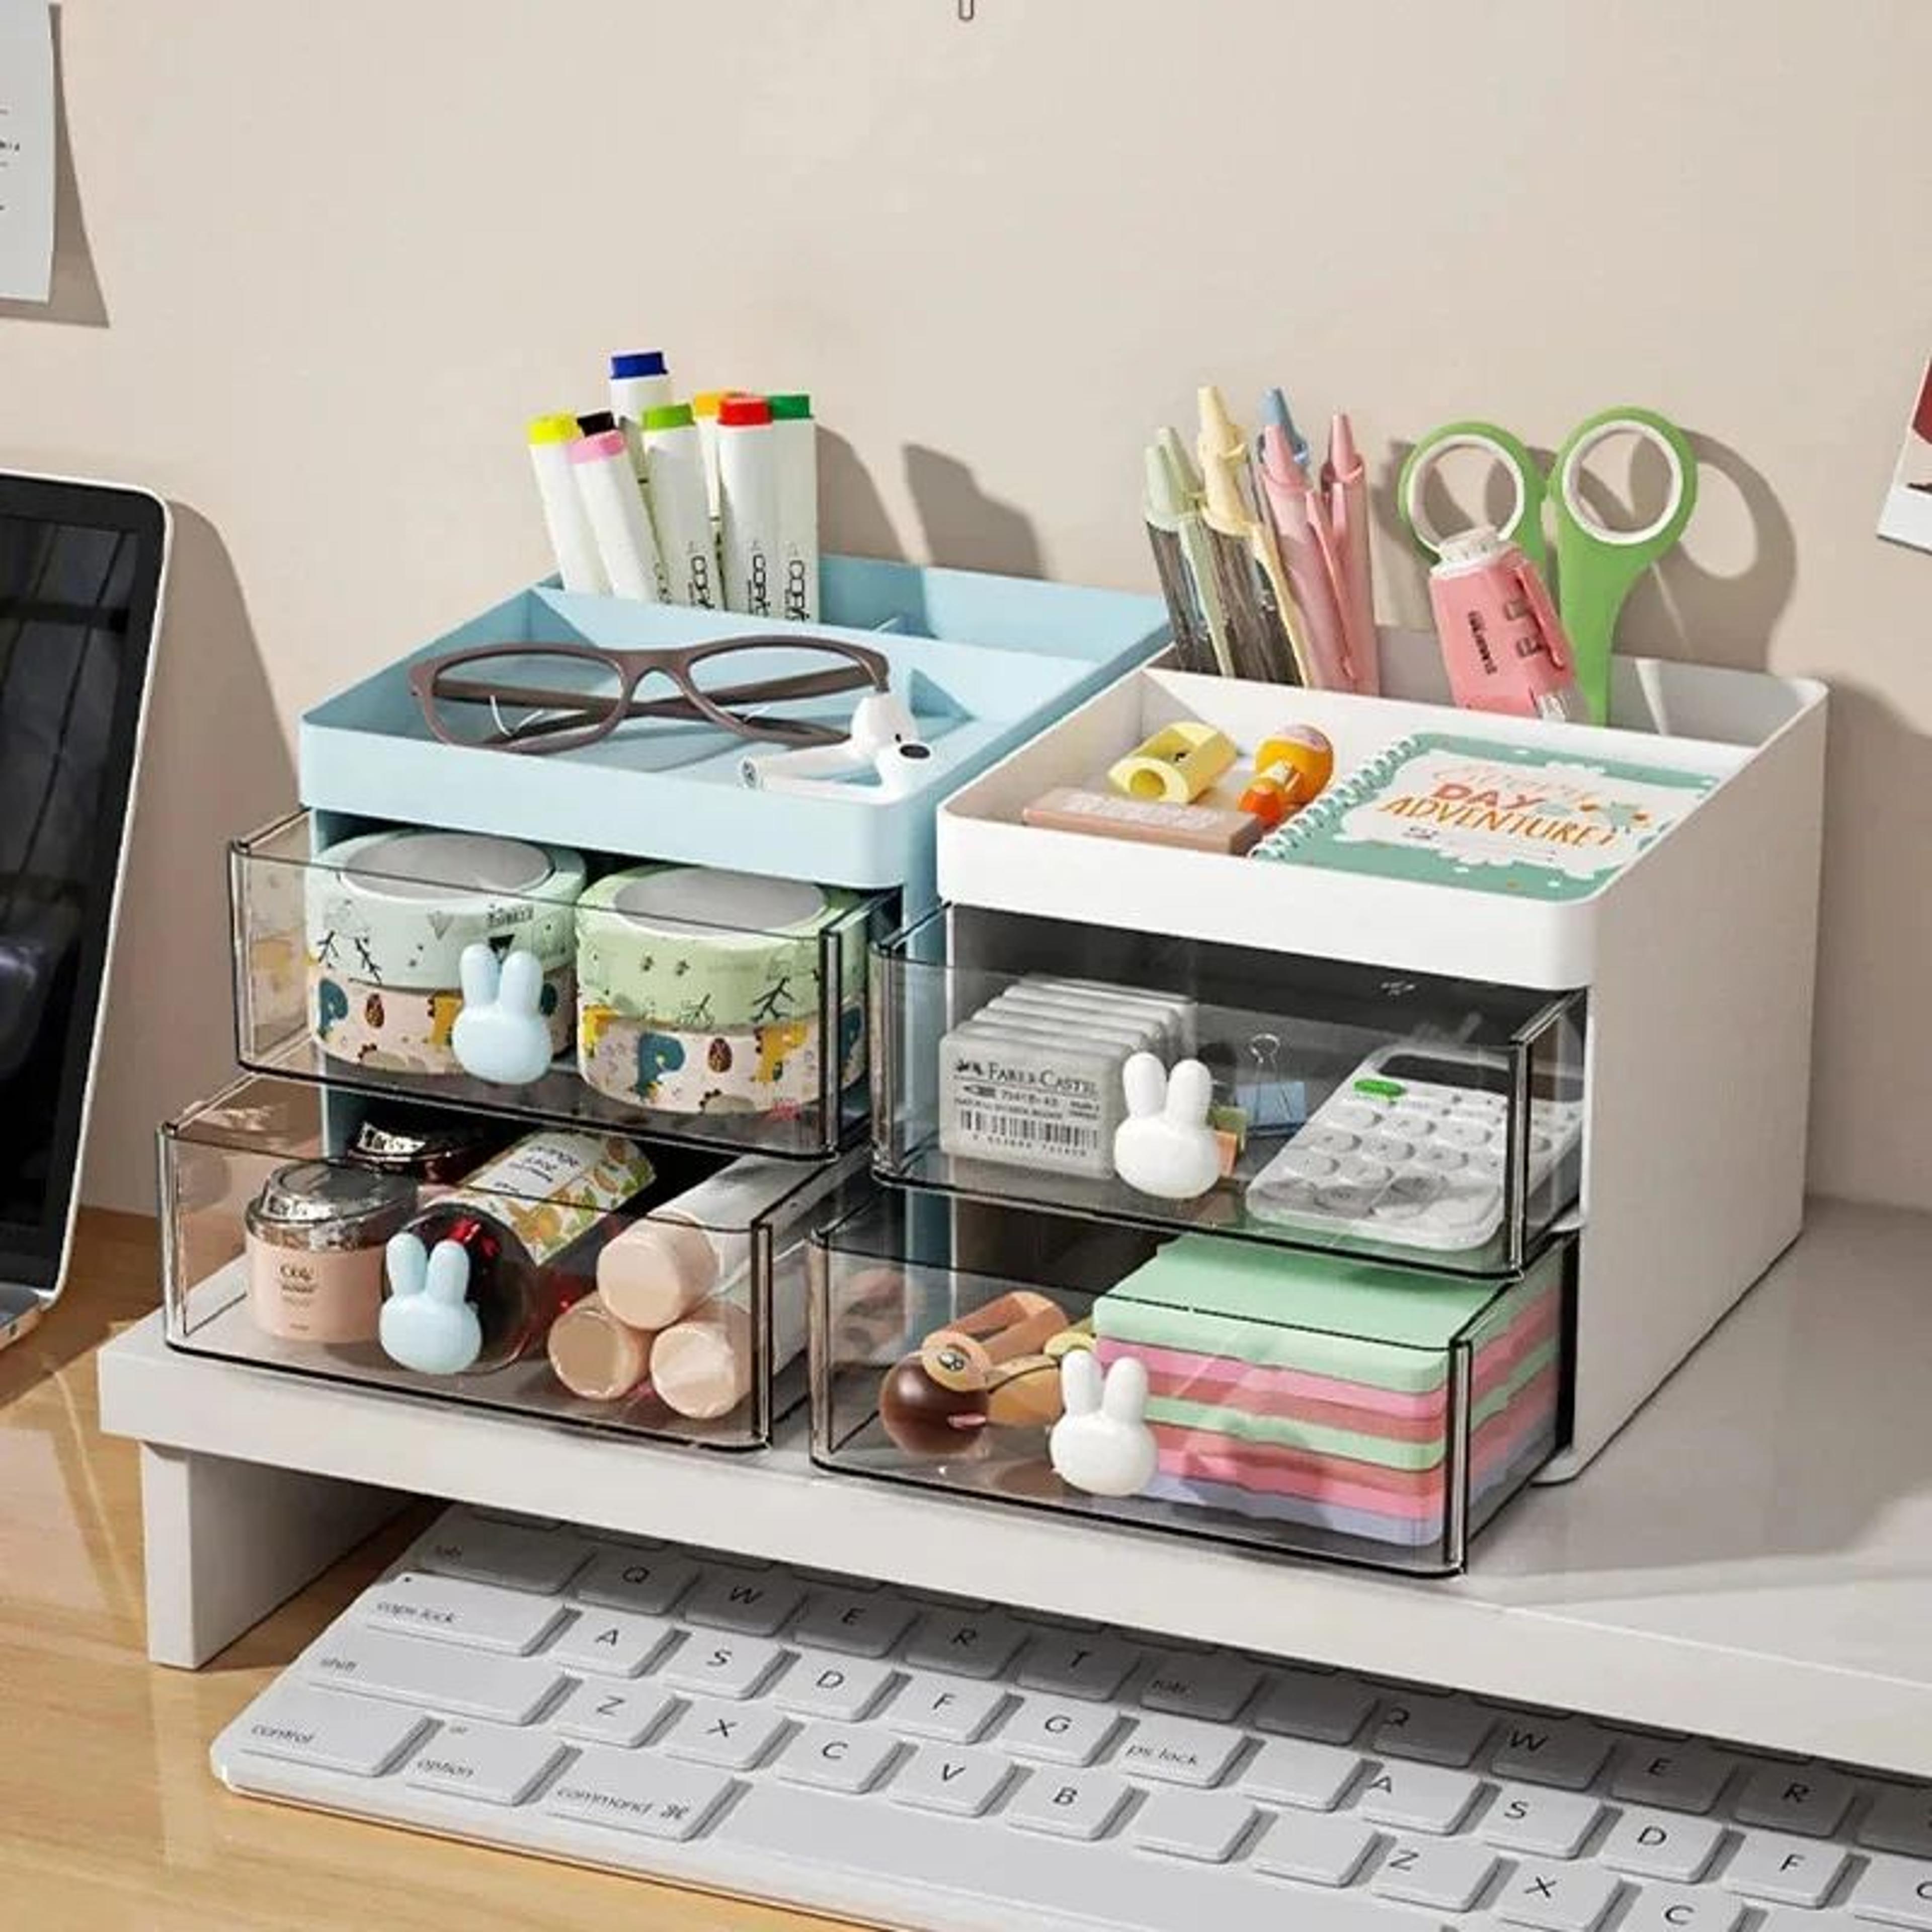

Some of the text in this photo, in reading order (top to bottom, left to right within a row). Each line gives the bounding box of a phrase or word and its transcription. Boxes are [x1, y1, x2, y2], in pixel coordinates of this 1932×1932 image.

[1430, 783, 1546, 809] DAY
[1378, 796, 1614, 846] ADVENTURE!
[623, 1567, 650, 1584] Q
[730, 1586, 763, 1604] W
[842, 1608, 864, 1625] E
[596, 1630, 618, 1645] A
[952, 1629, 977, 1646] R
[707, 1651, 732, 1665] S
[1071, 1650, 1091, 1667] T
[817, 1671, 844, 1688] D
[597, 1697, 625, 1715] Z
[933, 1694, 954, 1709] F
[708, 1719, 735, 1737] X
[1045, 1716, 1071, 1732] G
[252, 1726, 314, 1743] control
[1510, 1731, 1548, 1751] W
[822, 1742, 848, 1759] C
[418, 1760, 473, 1777] option
[943, 1763, 965, 1781] V
[1648, 1758, 1670, 1775] E
[1370, 1776, 1393, 1794] A
[1783, 1783, 1809, 1803] R
[557, 1787, 653, 1814] command
[1053, 1788, 1077, 1804] B
[1504, 1802, 1527, 1818] S
[1638, 1826, 1666, 1845] D
[1390, 1849, 1420, 1871] Z
[1780, 1854, 1805, 1871] F
[1525, 1877, 1556, 1898] X
[1665, 1906, 1693, 1924] C
